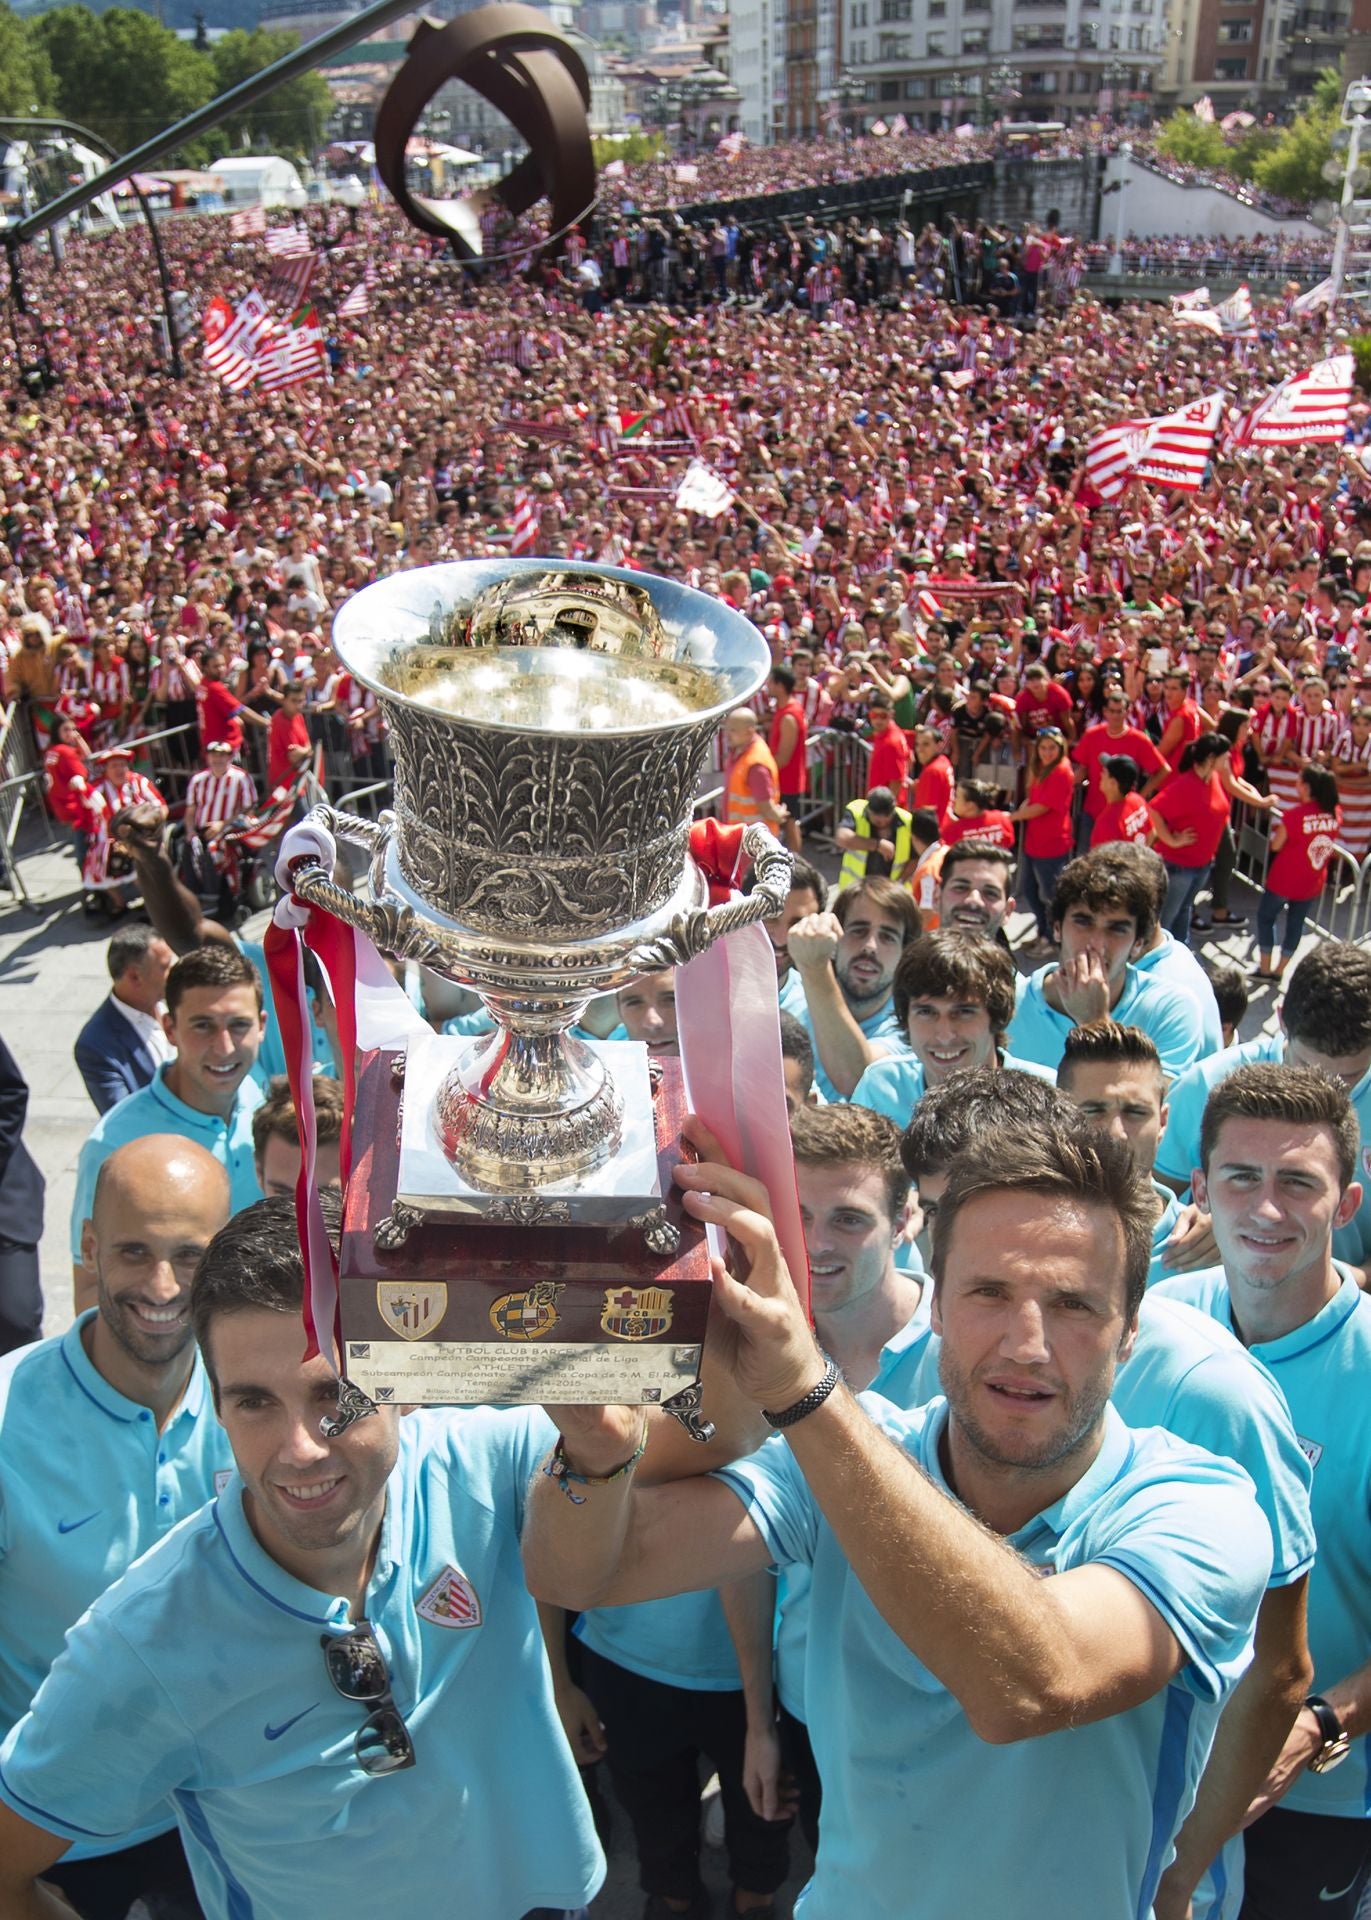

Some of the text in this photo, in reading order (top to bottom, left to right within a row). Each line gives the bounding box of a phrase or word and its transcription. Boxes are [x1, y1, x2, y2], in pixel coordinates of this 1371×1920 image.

[479, 947, 604, 968] SUPERCOPA
[467, 970, 547, 987] TEMPORADA
[495, 1347, 527, 1355] CLUB
[532, 1347, 609, 1355] BARCELA
[409, 1354, 639, 1363] Campeón Campeonato Nonal de Liga
[361, 1370, 433, 1379] Subcampeón
[437, 1370, 506, 1379] Campeonato
[571, 1371, 598, 1380] Copa
[601, 1371, 616, 1379] de
[422, 1573, 453, 1609] ATHLETIC CLUB
